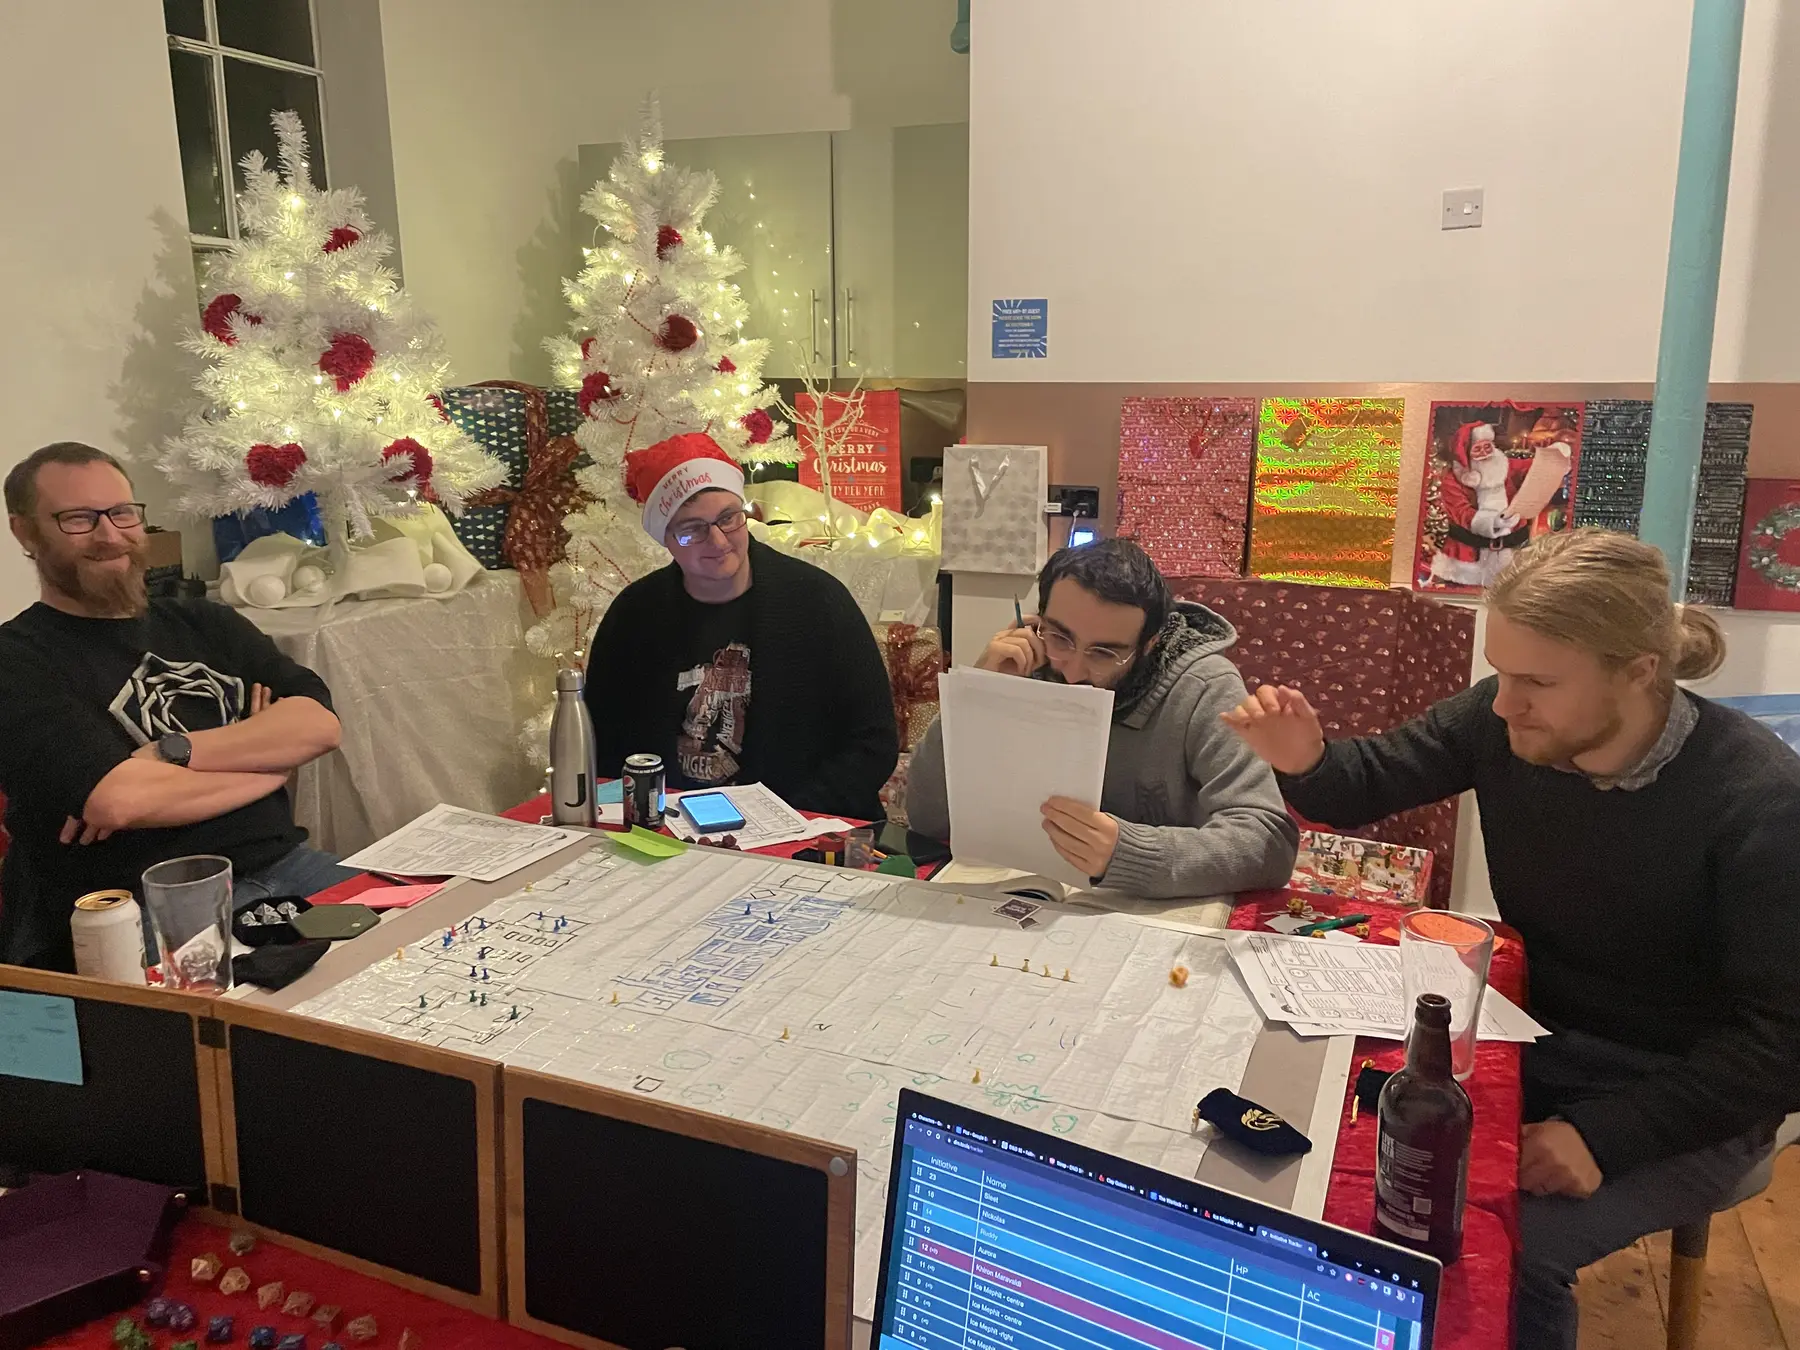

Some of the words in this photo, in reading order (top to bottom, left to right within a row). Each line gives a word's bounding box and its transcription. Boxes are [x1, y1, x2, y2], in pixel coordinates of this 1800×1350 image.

[827, 444, 874, 454] MERRY
[658, 472, 712, 518] Christmas
[930, 1156, 958, 1173] Initiative
[929, 1172, 937, 1181] 23
[986, 1175, 1007, 1190] Name
[926, 1208, 932, 1216] 14
[924, 1225, 931, 1234] 12
[921, 1242, 929, 1252] 12
[978, 1245, 997, 1259] Aurora
[919, 1260, 926, 1268] 11
[1235, 1264, 1249, 1276] HP
[974, 1281, 983, 1292] Ice
[983, 1284, 1002, 1300] Mephit
[1006, 1295, 1025, 1308] centre
[1307, 1289, 1321, 1302] AC
[971, 1299, 981, 1310] Ice
[981, 1303, 1000, 1318] Mephit
[1004, 1313, 1023, 1327] centre
[969, 1317, 978, 1328] Ice
[979, 1320, 998, 1336] Mephit
[967, 1335, 977, 1346] Ice
